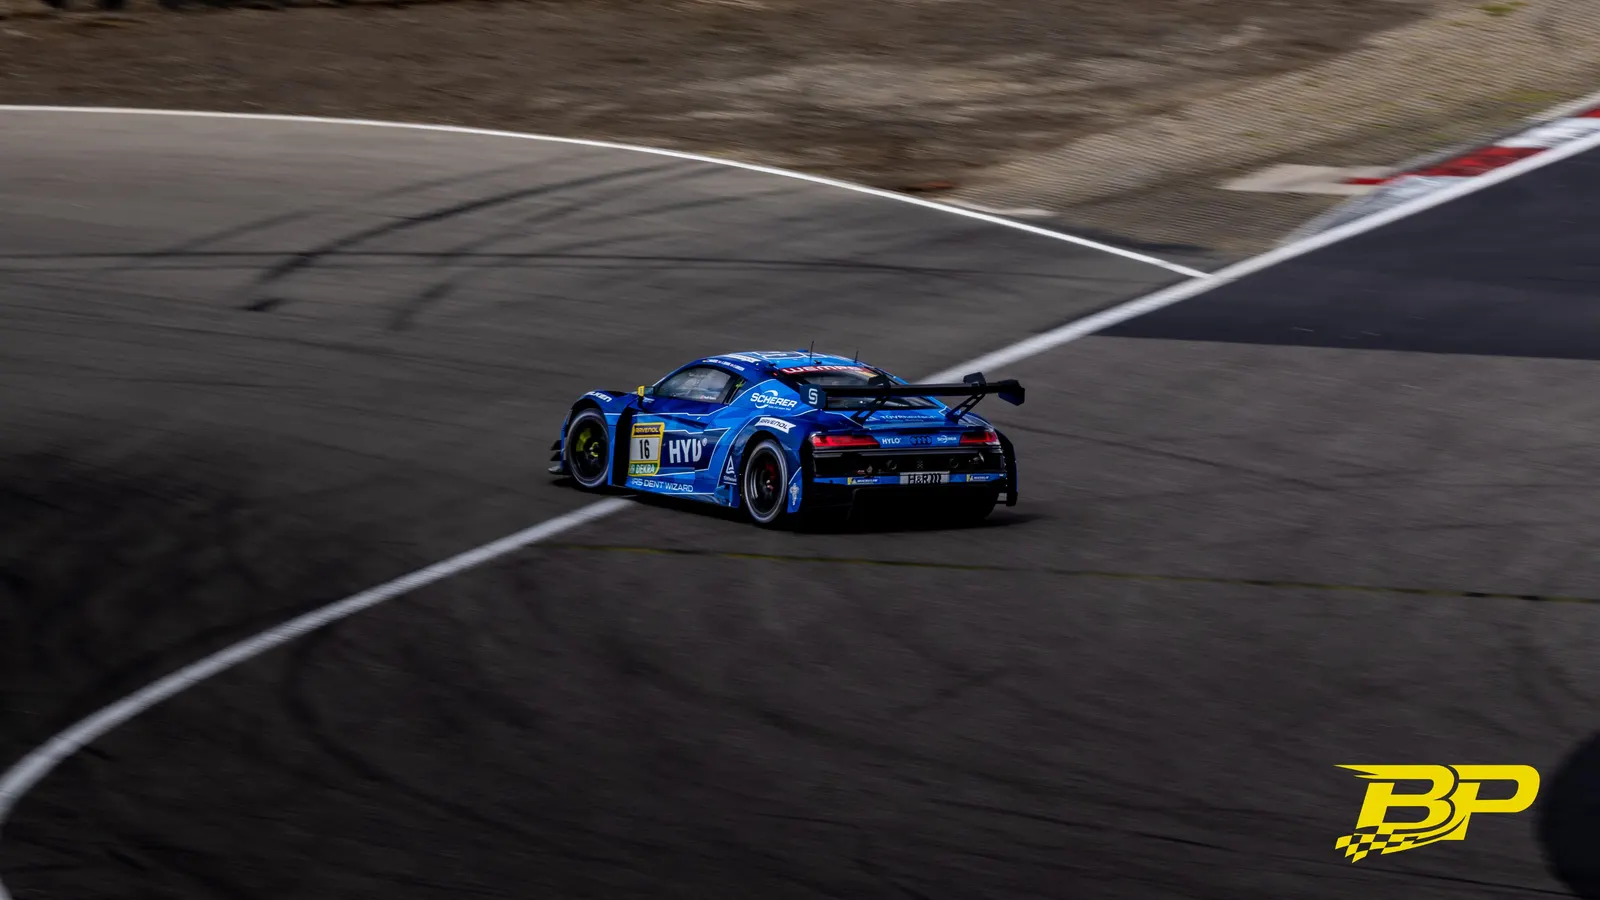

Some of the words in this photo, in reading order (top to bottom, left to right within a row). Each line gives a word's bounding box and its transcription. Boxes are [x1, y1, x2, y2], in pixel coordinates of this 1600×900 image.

[750, 392, 798, 408] SCHERER
[760, 418, 789, 430] RAVENOL
[639, 439, 650, 460] 16
[635, 464, 655, 474] DEKRA
[643, 479, 664, 489] DENT
[664, 482, 694, 493] WIZARD
